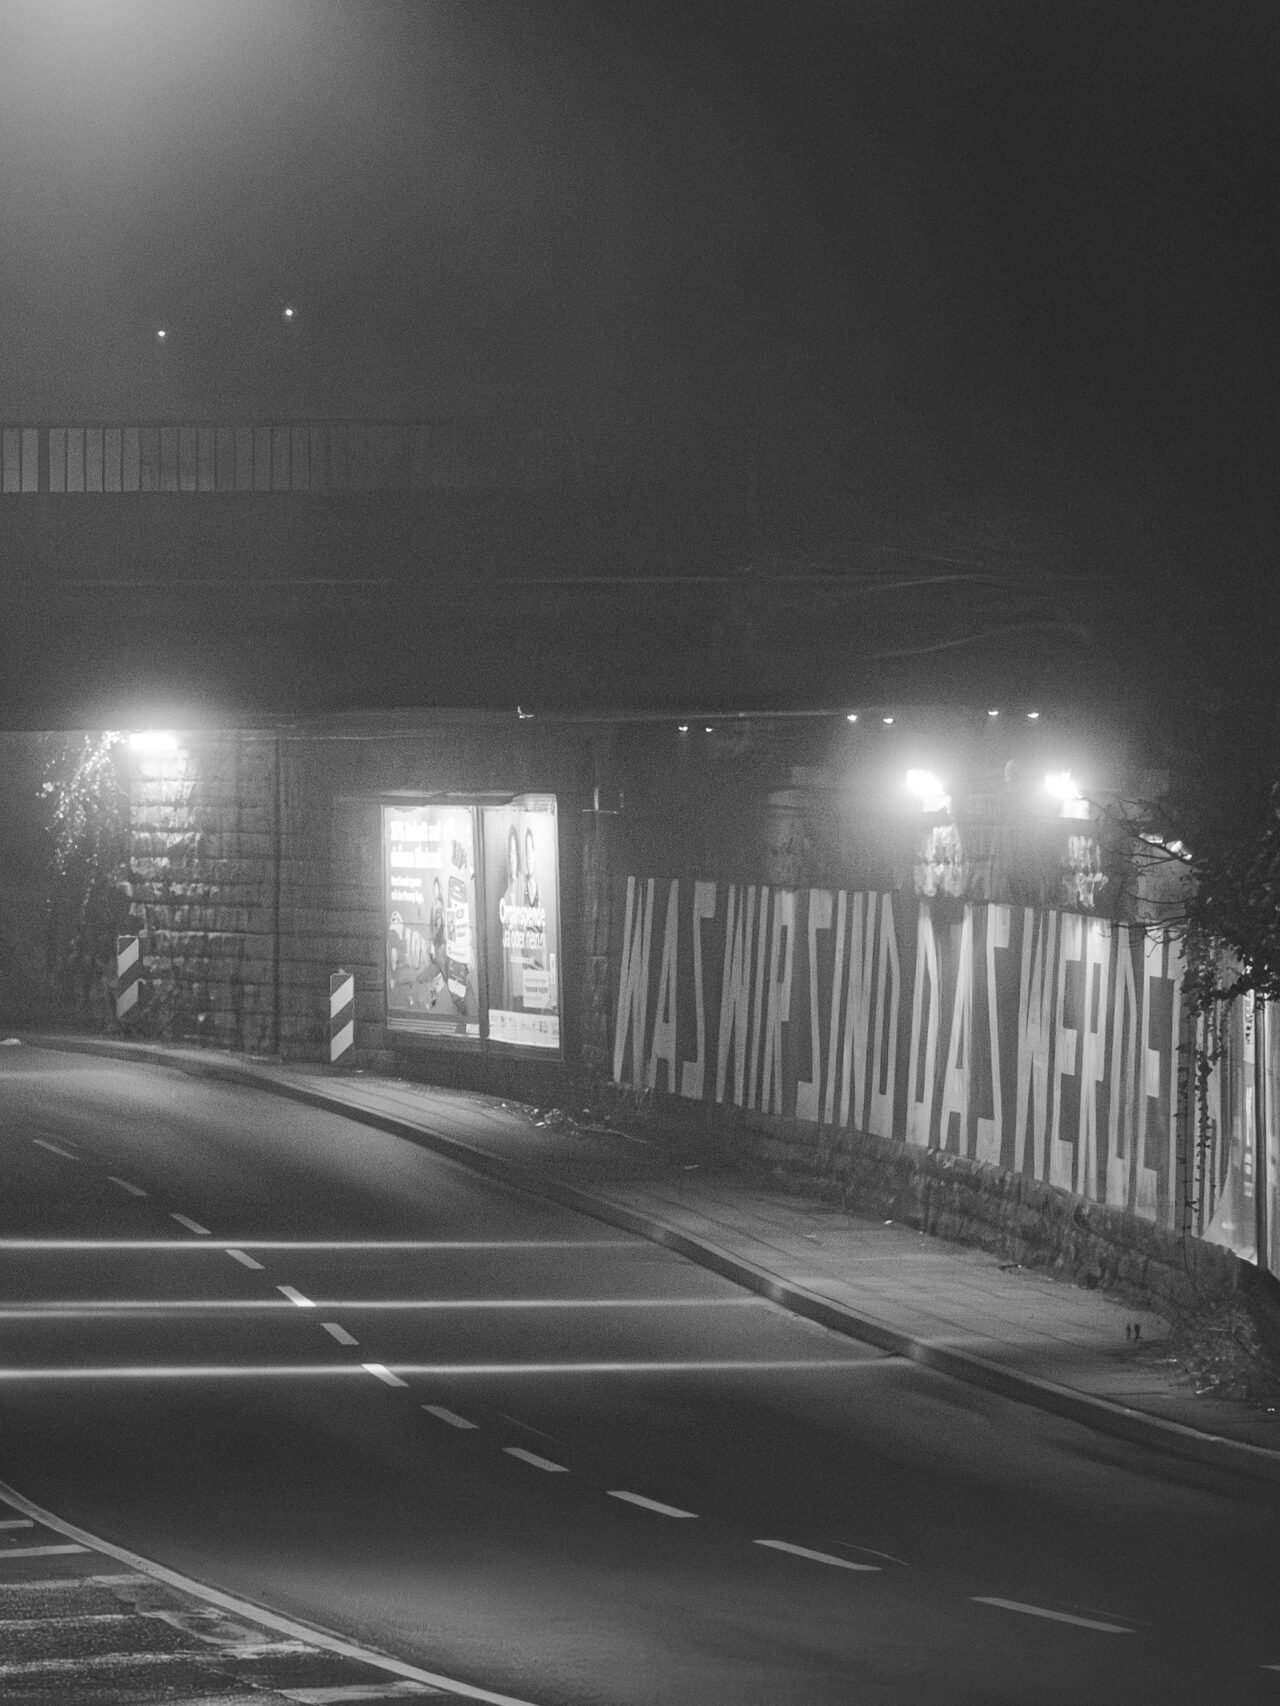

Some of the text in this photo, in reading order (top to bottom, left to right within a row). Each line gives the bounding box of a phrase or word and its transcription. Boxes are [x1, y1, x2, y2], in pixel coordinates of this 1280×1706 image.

[613, 876, 716, 1100] WAS
[716, 884, 796, 1114] WIR
[796, 888, 900, 1139] SIND
[906, 902, 1010, 1166] DAS
